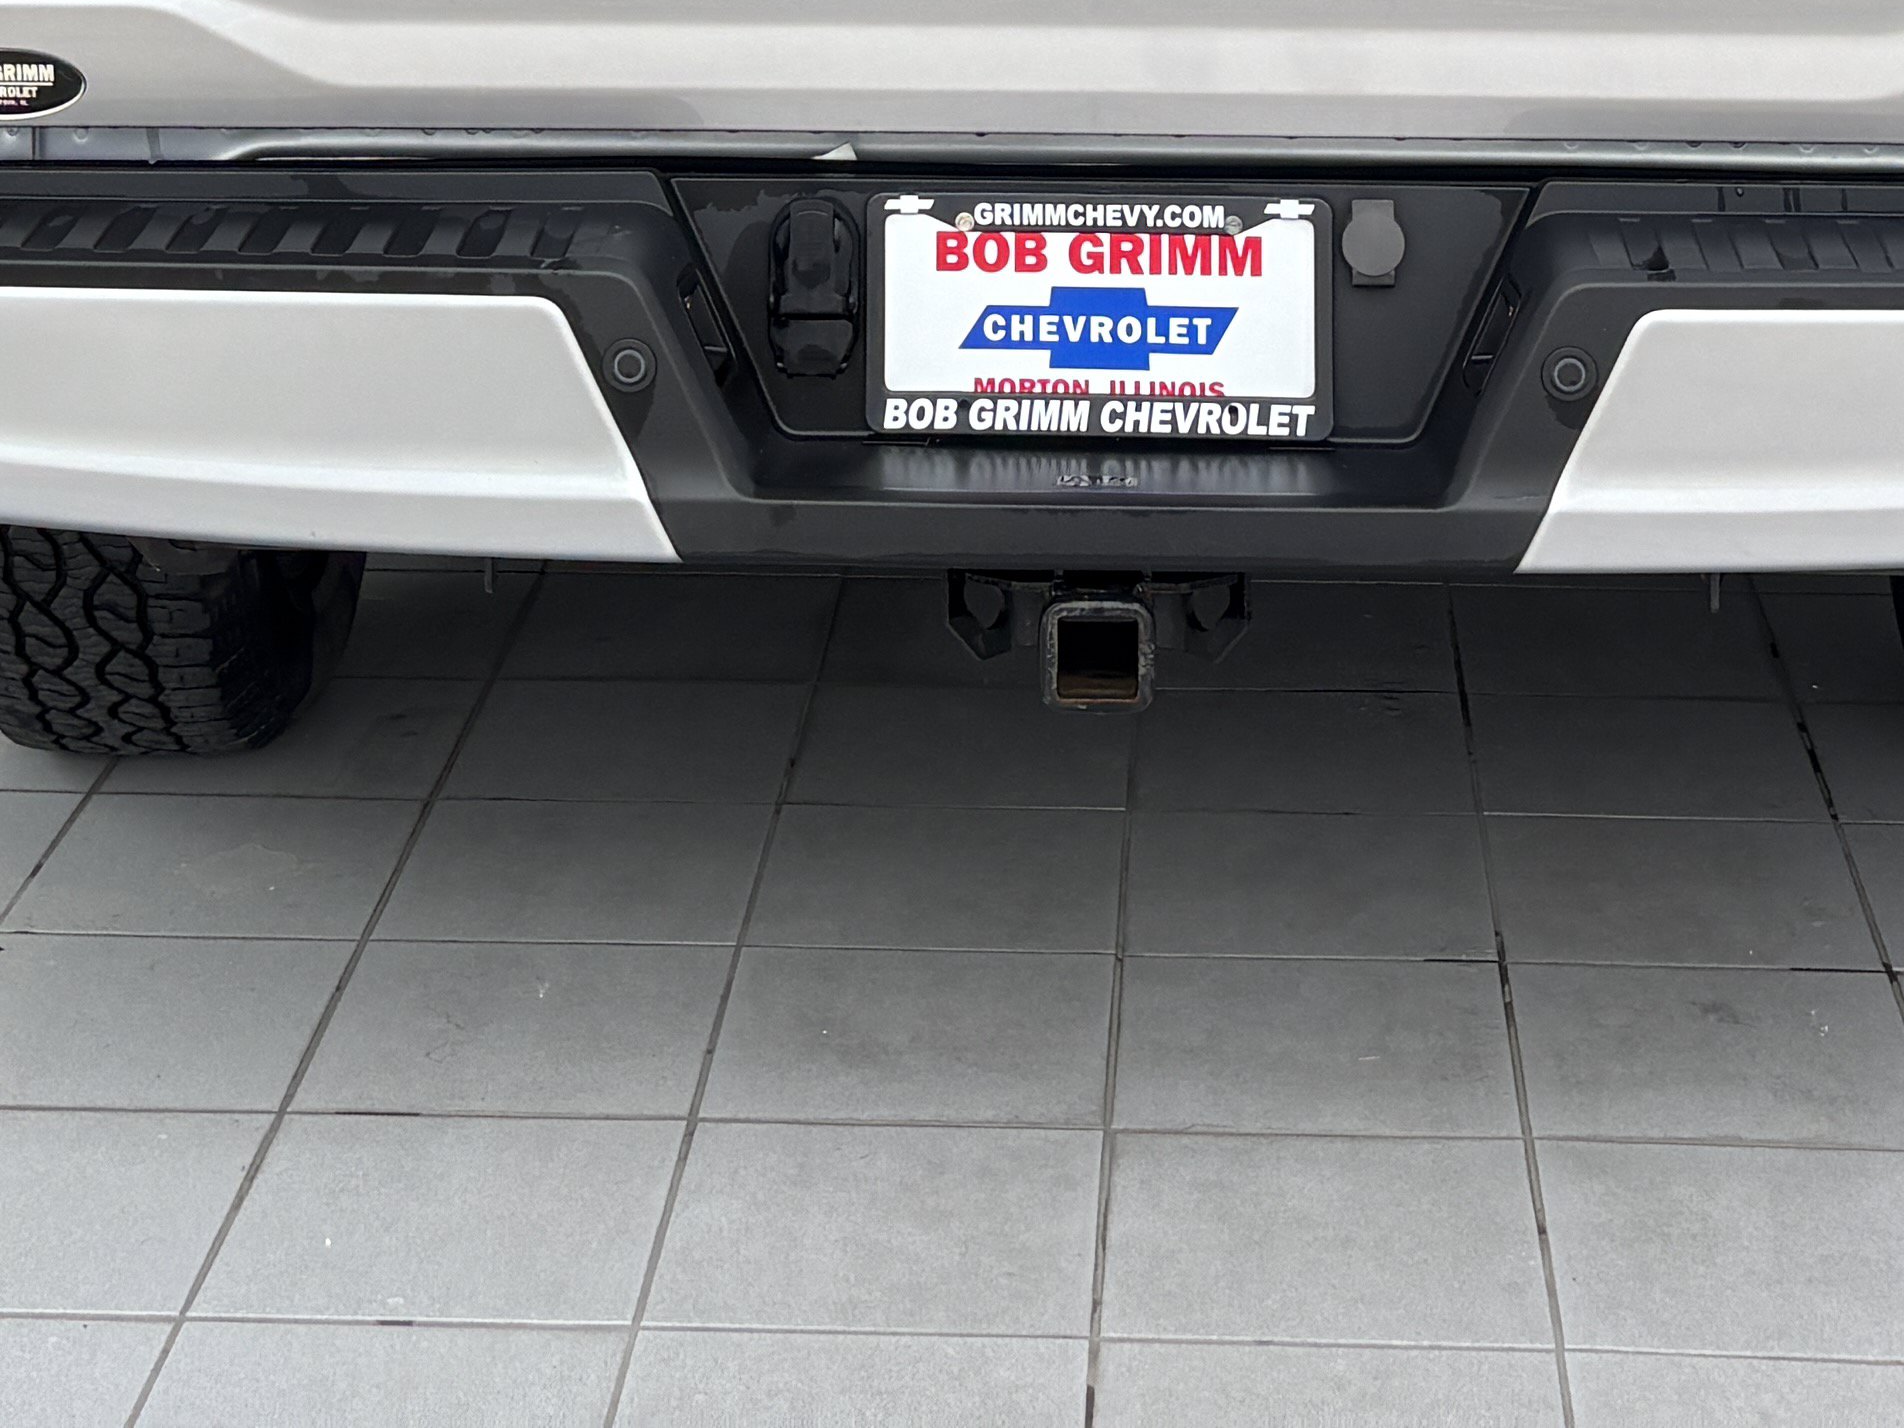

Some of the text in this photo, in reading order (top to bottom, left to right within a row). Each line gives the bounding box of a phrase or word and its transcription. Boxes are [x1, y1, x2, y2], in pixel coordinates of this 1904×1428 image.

[973, 202, 1226, 229] GRIMMCHEVY.COM
[936, 231, 1263, 277] BOB GRIMM
[982, 314, 1213, 346] CHEVROLET
[882, 397, 1316, 437] BOB GRIMM CHEVROLET
